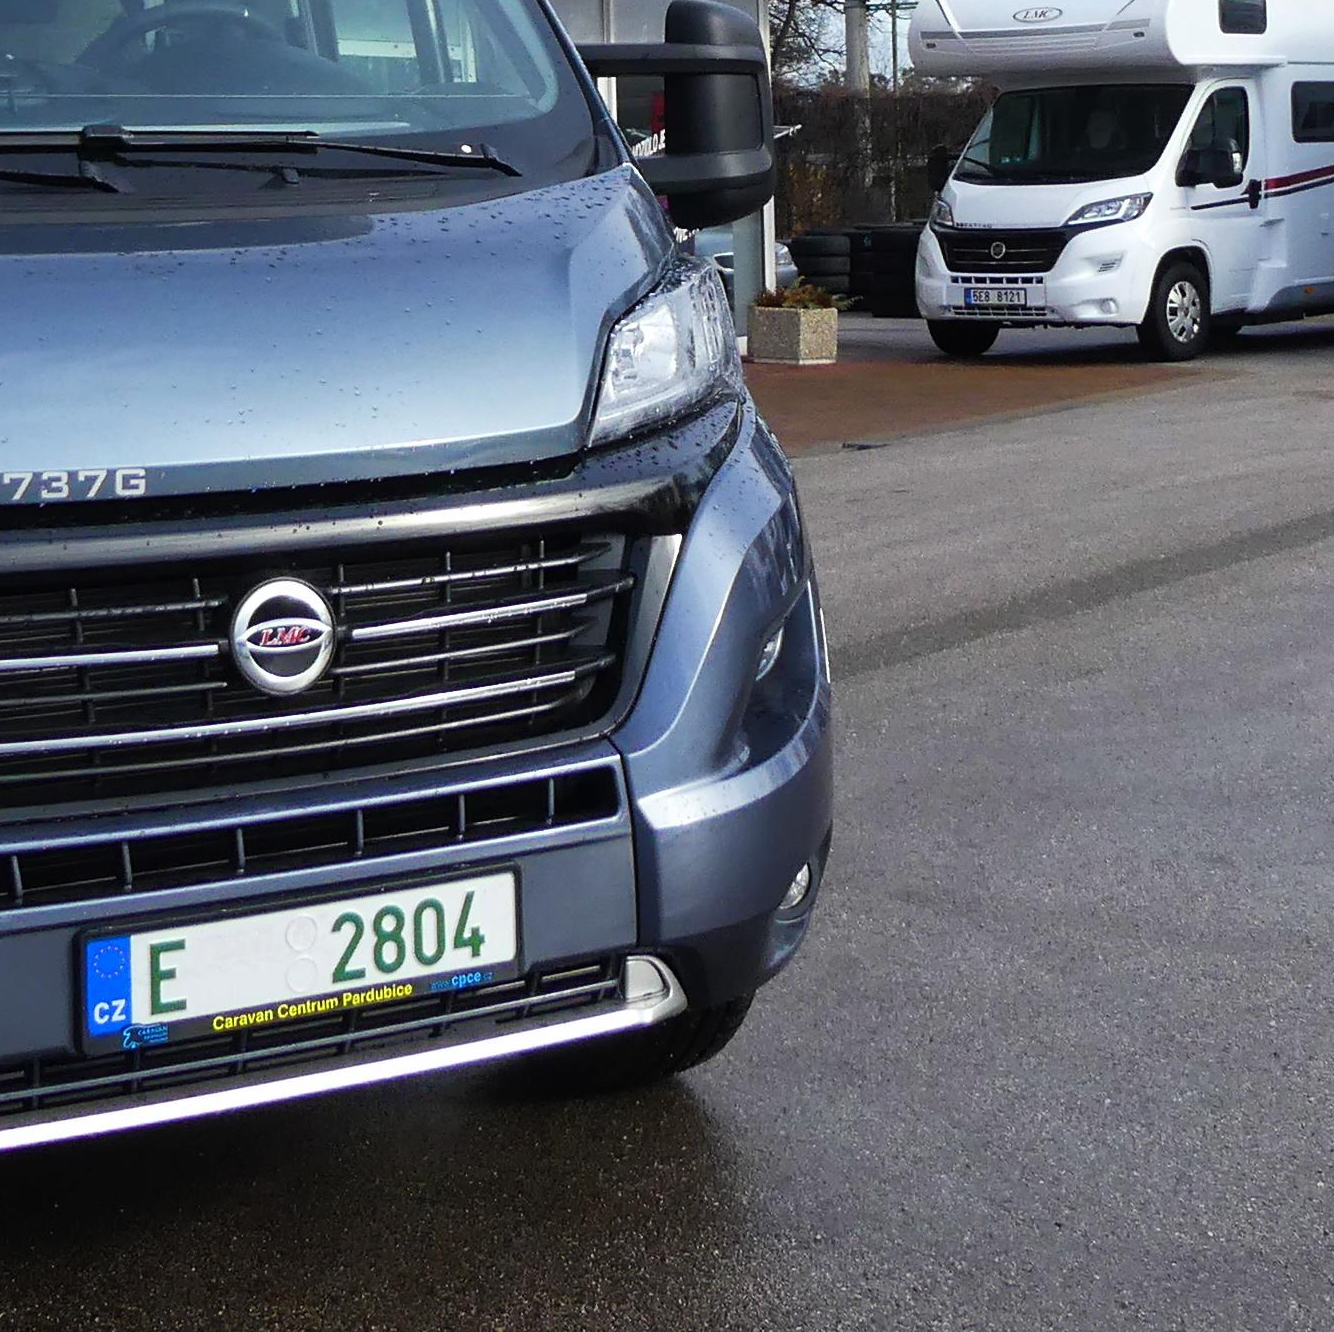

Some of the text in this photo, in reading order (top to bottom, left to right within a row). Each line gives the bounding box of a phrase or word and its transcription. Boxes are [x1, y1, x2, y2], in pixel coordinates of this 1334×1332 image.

[997, 290, 1021, 303] 8121
[259, 624, 311, 647] LMC
[148, 890, 485, 1016] E 2804
[93, 998, 127, 1024] CZ
[213, 982, 413, 1031] Caravan Centrum Pardubice
